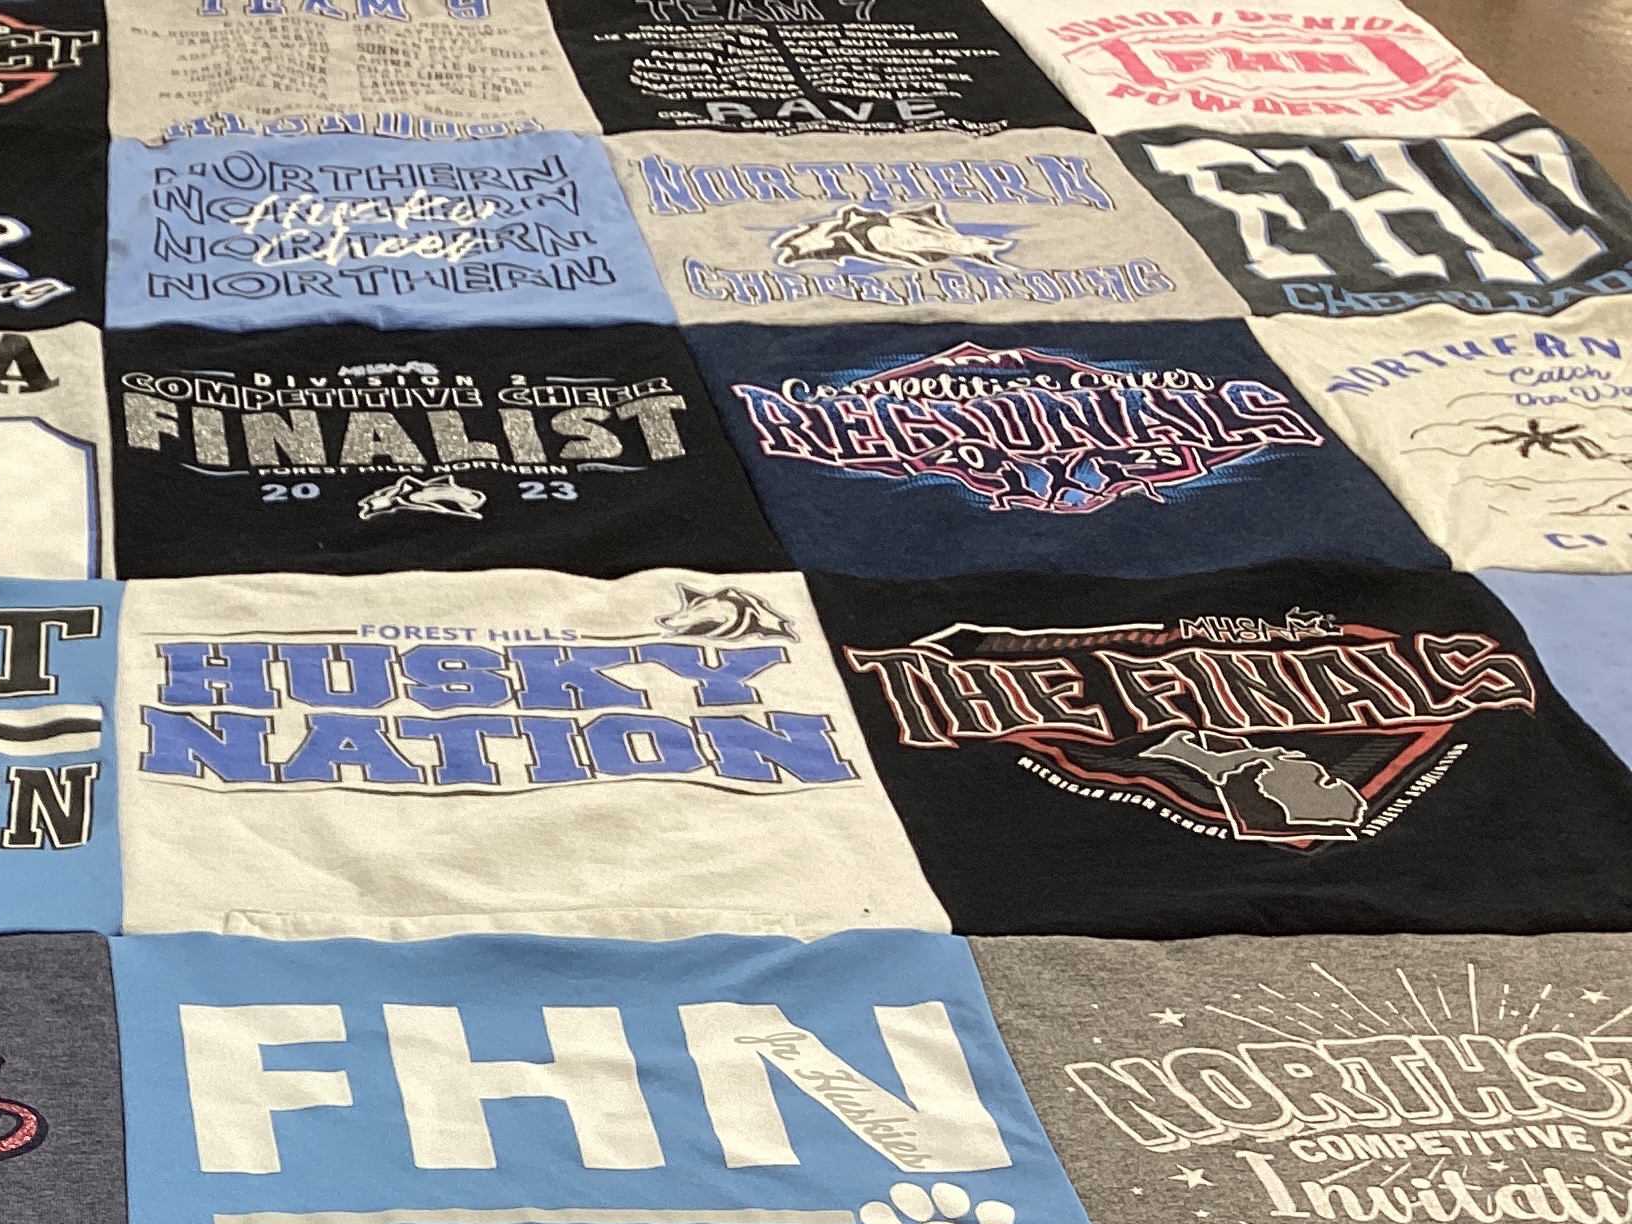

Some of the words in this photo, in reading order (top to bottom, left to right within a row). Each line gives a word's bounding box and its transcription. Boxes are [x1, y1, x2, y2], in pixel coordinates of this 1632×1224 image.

[635, 0, 825, 22] TEAM
[1047, 11, 1199, 43] JUNIOR
[1235, 9, 1424, 35] SENIOR
[706, 99, 947, 123] RAVE
[1107, 83, 1361, 116] POWDER
[154, 150, 570, 194] NORTHERN
[632, 154, 1117, 215] NORTHERN
[154, 181, 580, 224] NORTHERN
[154, 216, 598, 263] NORTHERN
[148, 257, 620, 300] NORTHERN
[684, 257, 1178, 307] CHEERLEADING
[254, 373, 475, 387] DIVISION
[510, 374, 528, 387] 2
[1326, 332, 1623, 397] NORTHERN
[122, 372, 483, 411] COMPETITIVE
[499, 376, 674, 408] CHEER
[783, 371, 1060, 405] Competitive
[122, 391, 688, 467] FINALIST
[733, 379, 1326, 465] REGIONALS
[258, 465, 350, 477] FOREST
[359, 464, 423, 475] HILLS
[433, 460, 569, 475] NORTHERN
[935, 445, 986, 468] 20
[1134, 446, 1181, 466] 25
[262, 482, 321, 501] 20
[519, 481, 578, 501] 23
[360, 623, 477, 643] FOREST
[488, 624, 579, 643] HILLS
[157, 641, 793, 710] HUSKY
[842, 645, 1114, 750] THE
[1099, 634, 1538, 738] FINALS
[139, 704, 863, 786] NATION
[1017, 756, 1106, 799] MICHIGAN
[1109, 791, 1156, 812] HIGH
[1158, 808, 1229, 840] SCHOOL
[179, 1001, 1013, 1174] FHN
[734, 1031, 808, 1061] Jr
[793, 1068, 932, 1170] Huskies
[1290, 1124, 1596, 1163] COMPETITIVE
